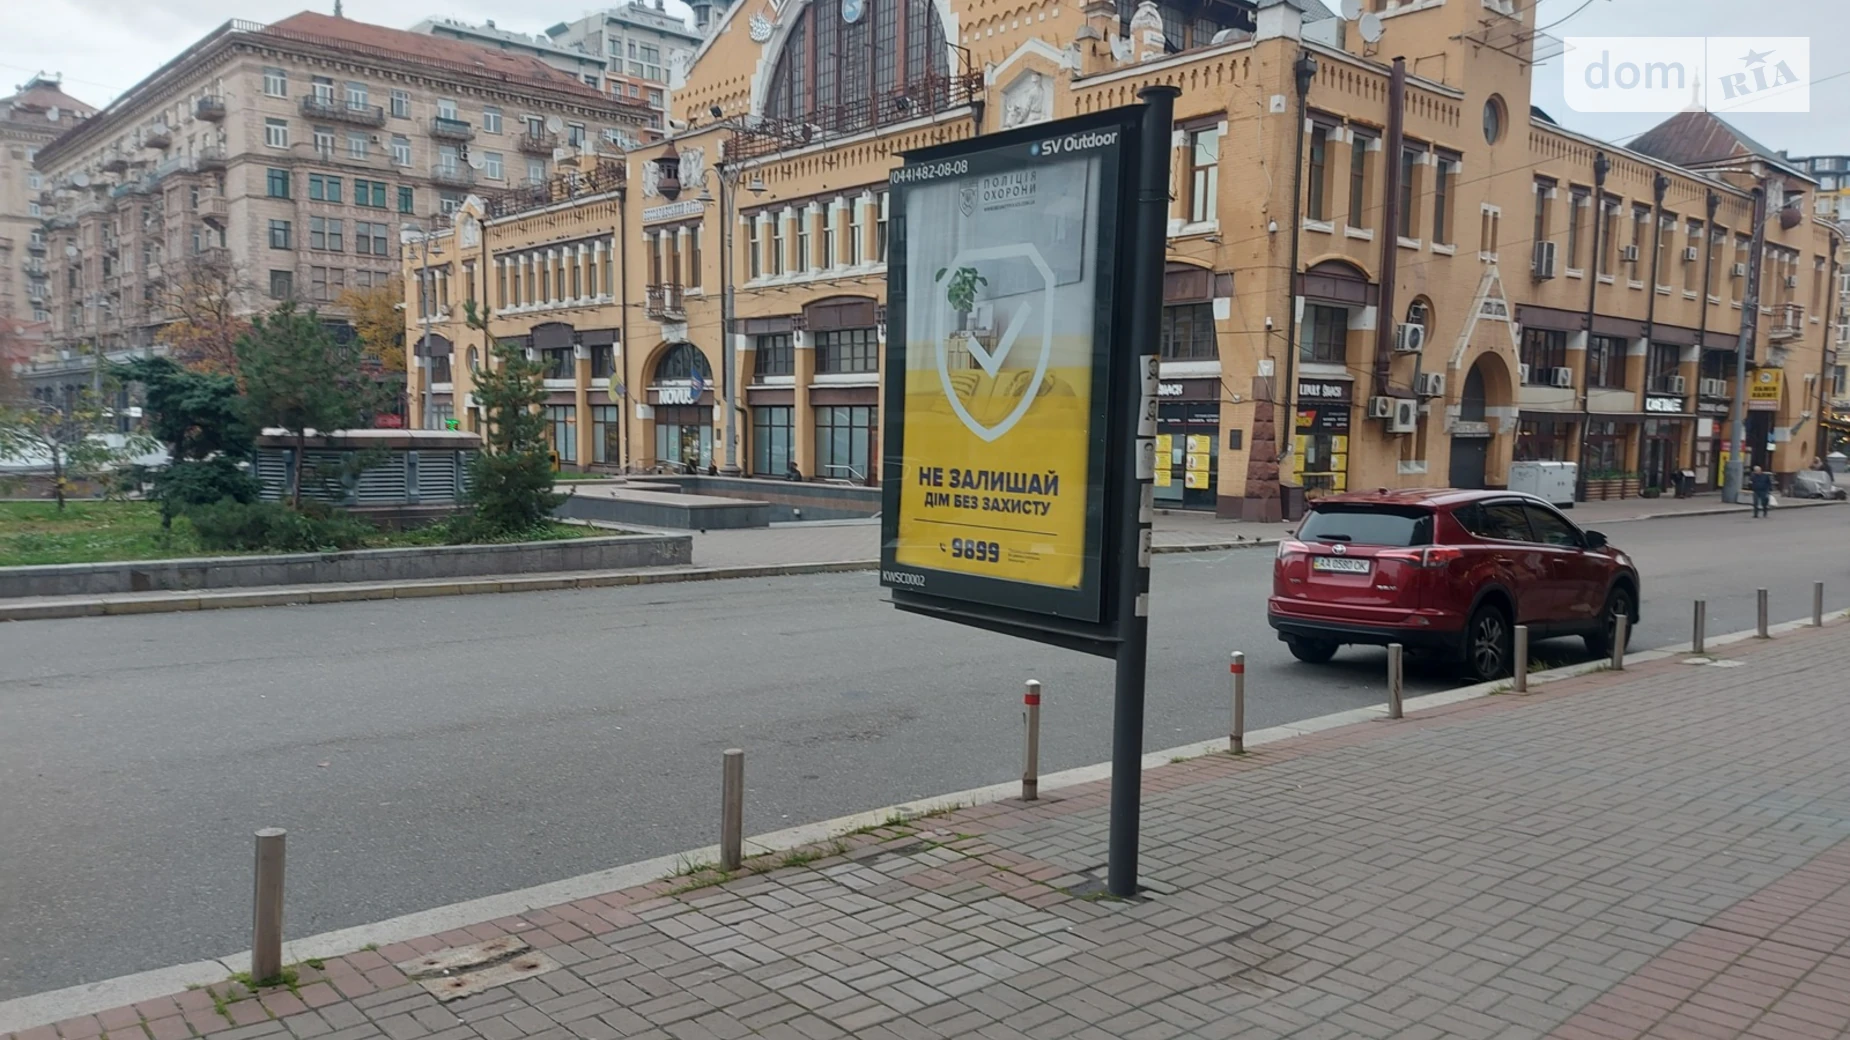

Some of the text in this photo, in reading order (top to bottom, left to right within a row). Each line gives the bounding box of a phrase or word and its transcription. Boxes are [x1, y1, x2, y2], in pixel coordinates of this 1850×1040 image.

[1041, 132, 1118, 156] SV Outdoor
[890, 160, 969, 185] (044)482-08-08
[983, 170, 1037, 189] ПОЛІЦІЯ
[983, 184, 1037, 202] ОХОРОНИ
[658, 388, 694, 405] NOVUS
[918, 466, 1059, 496] НЕ ЗАЛИШАЙ
[924, 492, 1051, 516] ДІМ БЕЗ ЗАХИСТУ
[951, 537, 1000, 563] 9899
